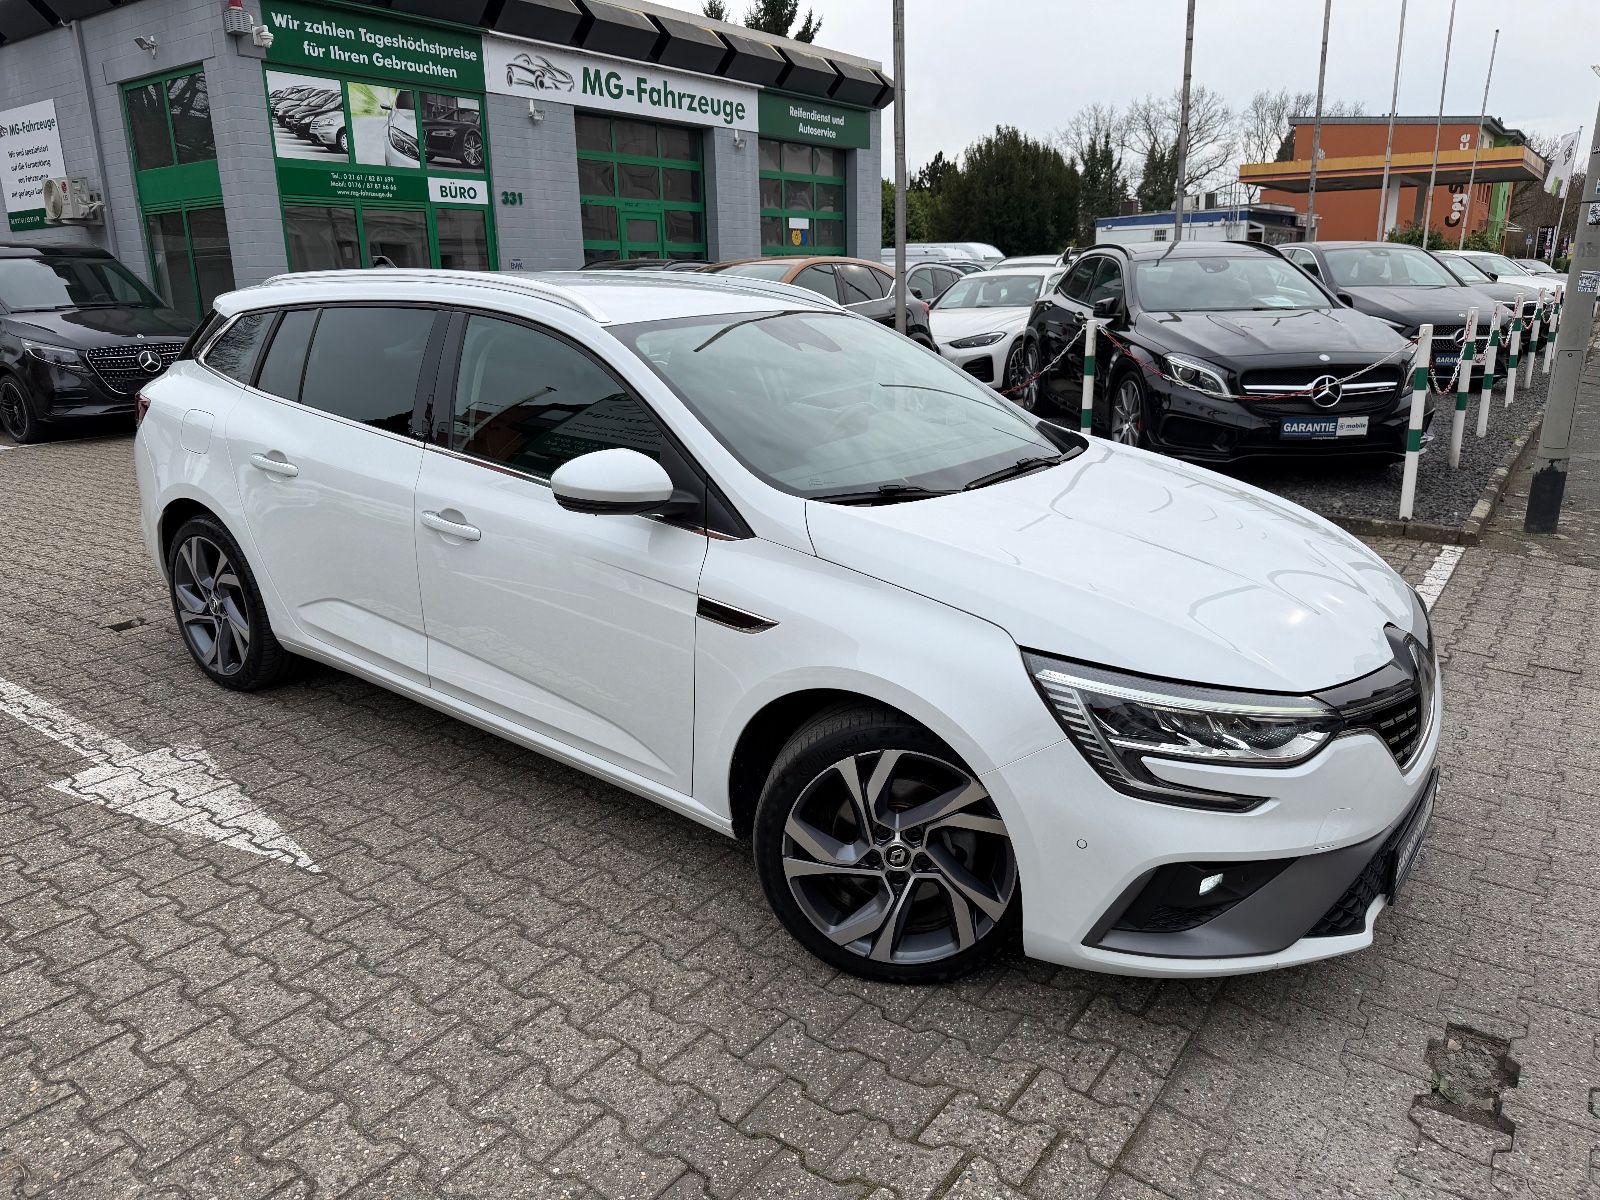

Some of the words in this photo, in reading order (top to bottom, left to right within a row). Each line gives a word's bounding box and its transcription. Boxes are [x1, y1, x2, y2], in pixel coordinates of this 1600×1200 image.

[271, 11, 299, 30] Wir
[304, 20, 355, 40] zahlen
[358, 27, 478, 61] Tageshöchstpreise
[303, 41, 325, 57] für
[329, 45, 368, 65] Ihren
[372, 52, 458, 79] Gebrauchten
[581, 66, 746, 124] MG-Fahrzeuge
[789, 105, 831, 123] Reifendienst
[831, 115, 845, 126] und
[9, 117, 55, 136] MG-Fahrzeuge
[798, 122, 836, 138] Autoservice
[439, 181, 477, 200] BÜRO
[502, 191, 523, 205] 331
[1283, 422, 1337, 432] GARANTIE
